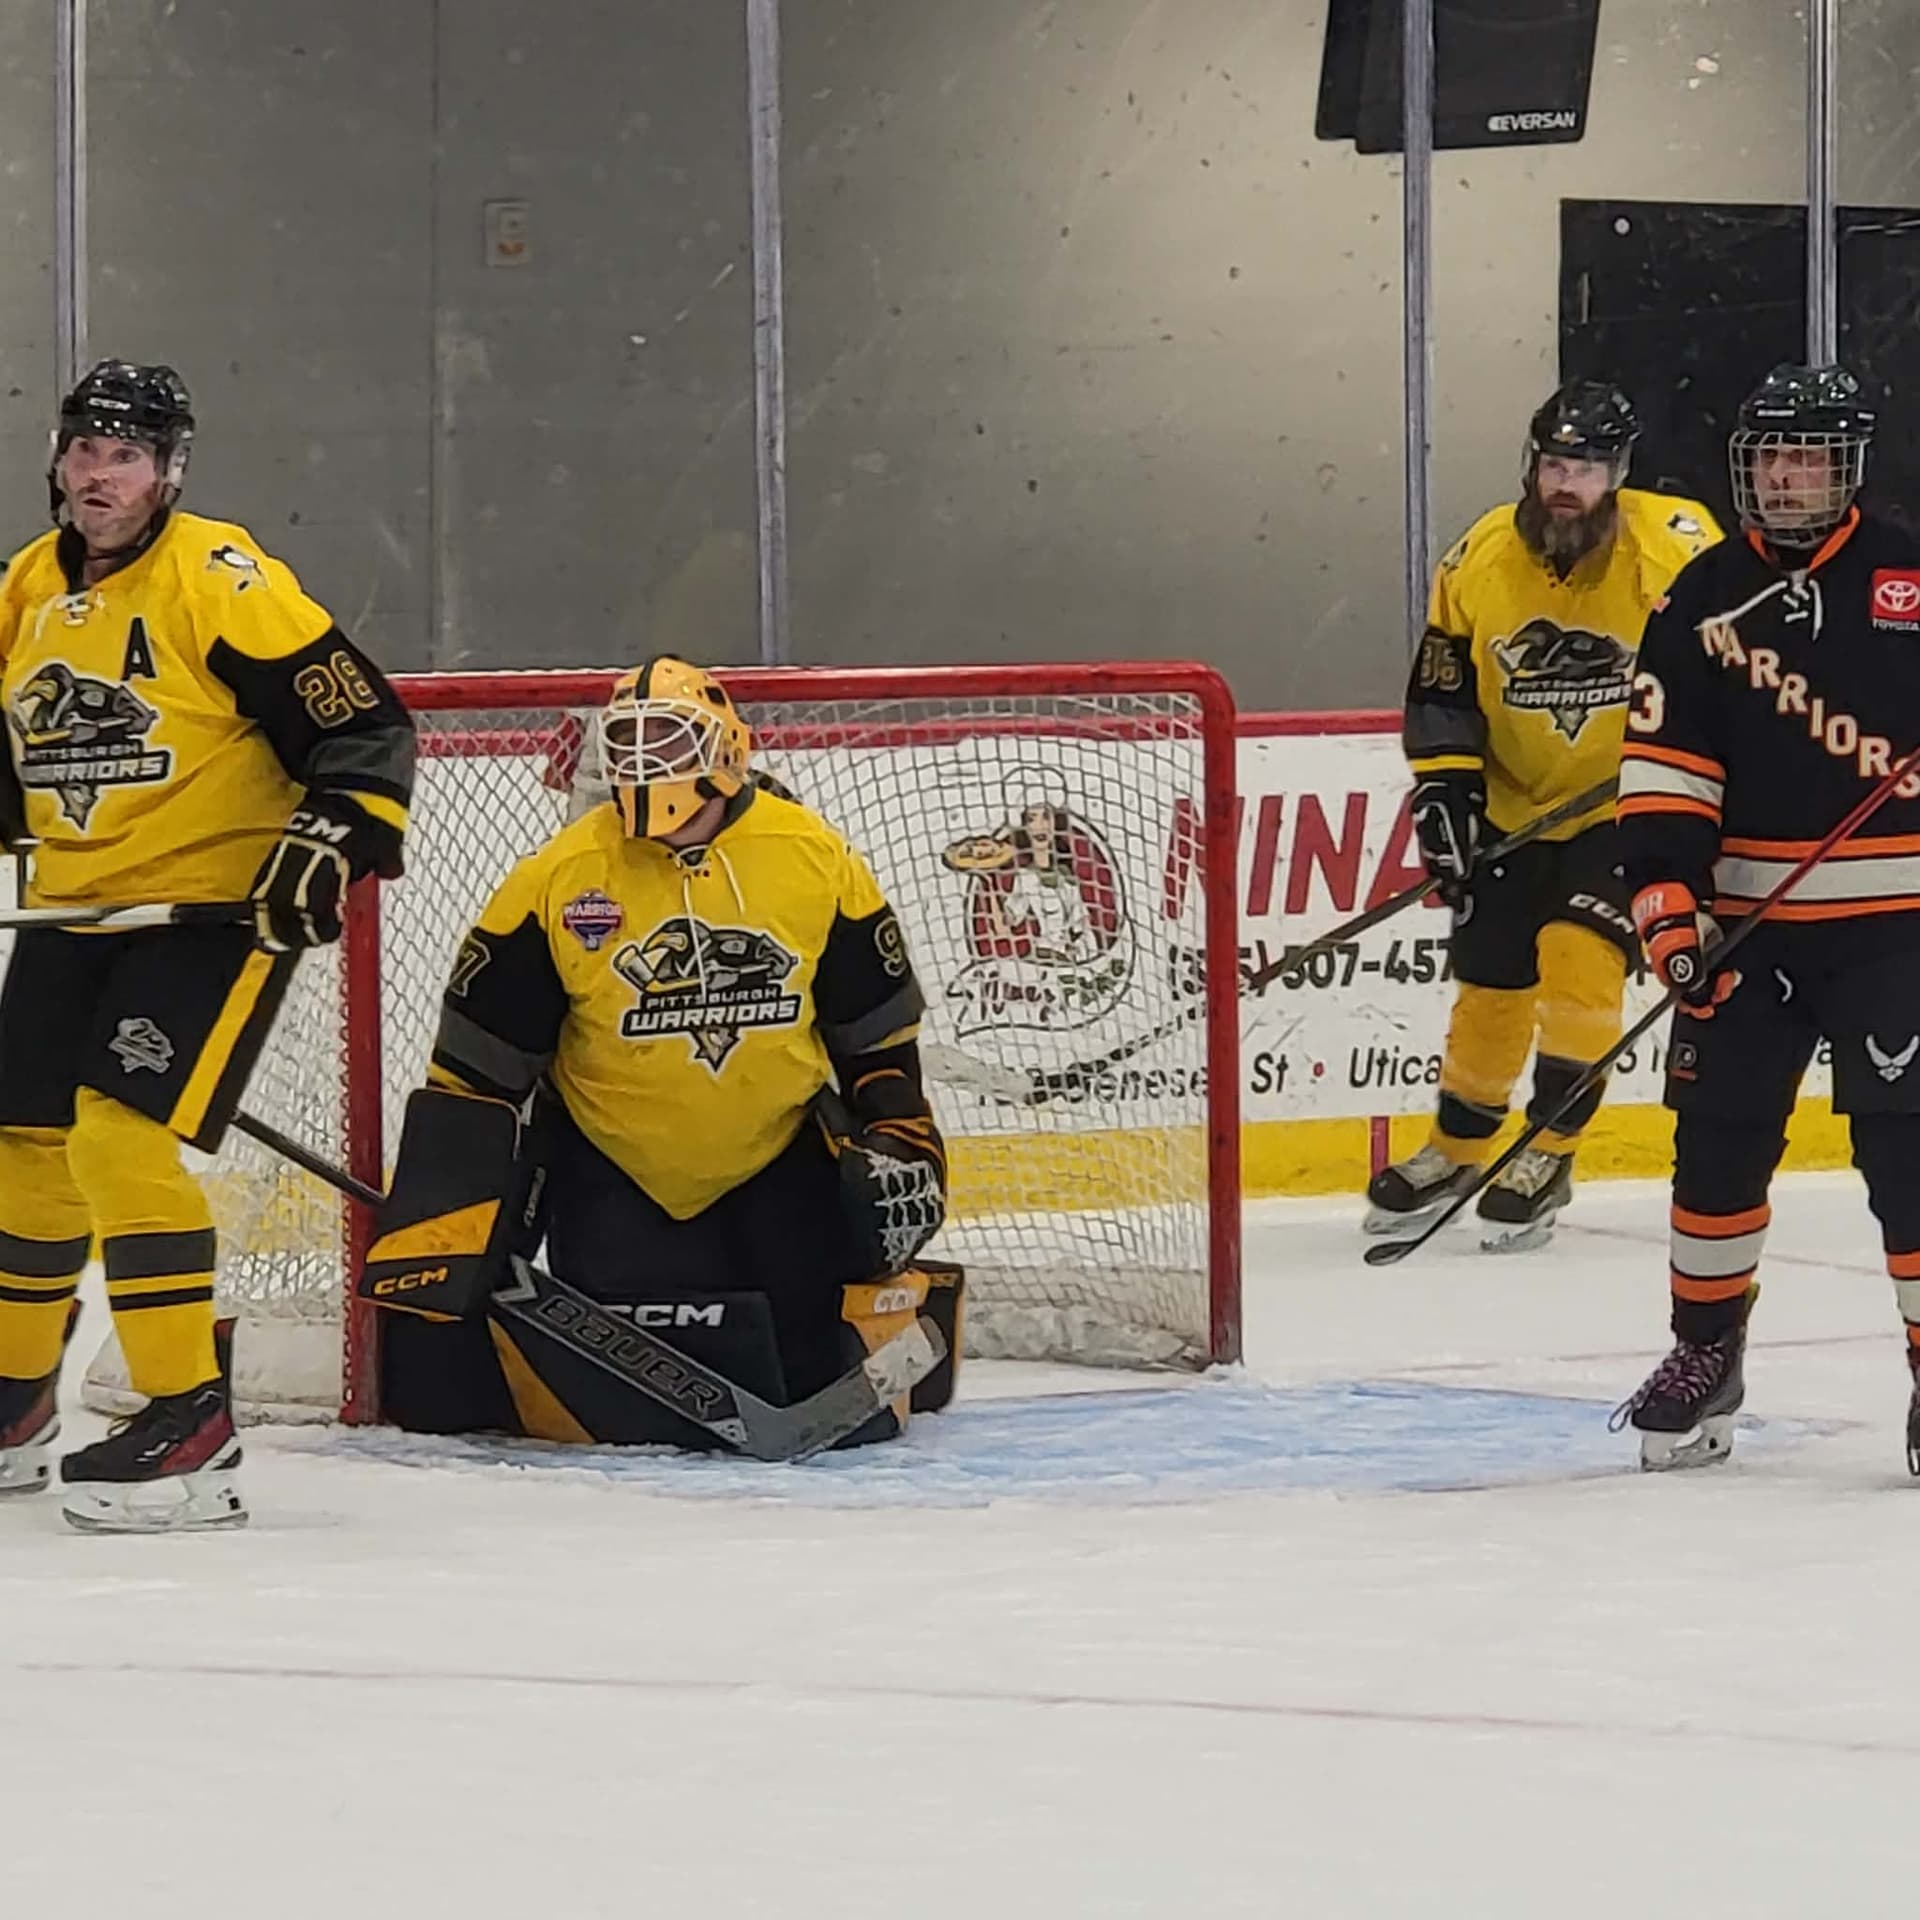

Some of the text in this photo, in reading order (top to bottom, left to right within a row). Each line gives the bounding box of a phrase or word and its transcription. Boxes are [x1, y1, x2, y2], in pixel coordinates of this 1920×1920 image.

[1500, 111, 1576, 131] EVERSAN
[122, 617, 156, 680] A
[294, 651, 379, 728] 28
[1630, 672, 1666, 733] 3
[285, 811, 352, 843] CM
[450, 936, 492, 998] 7
[1282, 939, 1451, 989] 507-457
[629, 1000, 797, 1032] WARRIORS
[646, 988, 778, 1009] PITTSBURGH
[1251, 1051, 1289, 1094] St
[1349, 1045, 1442, 1089] Utica
[374, 1266, 448, 1296] CCM
